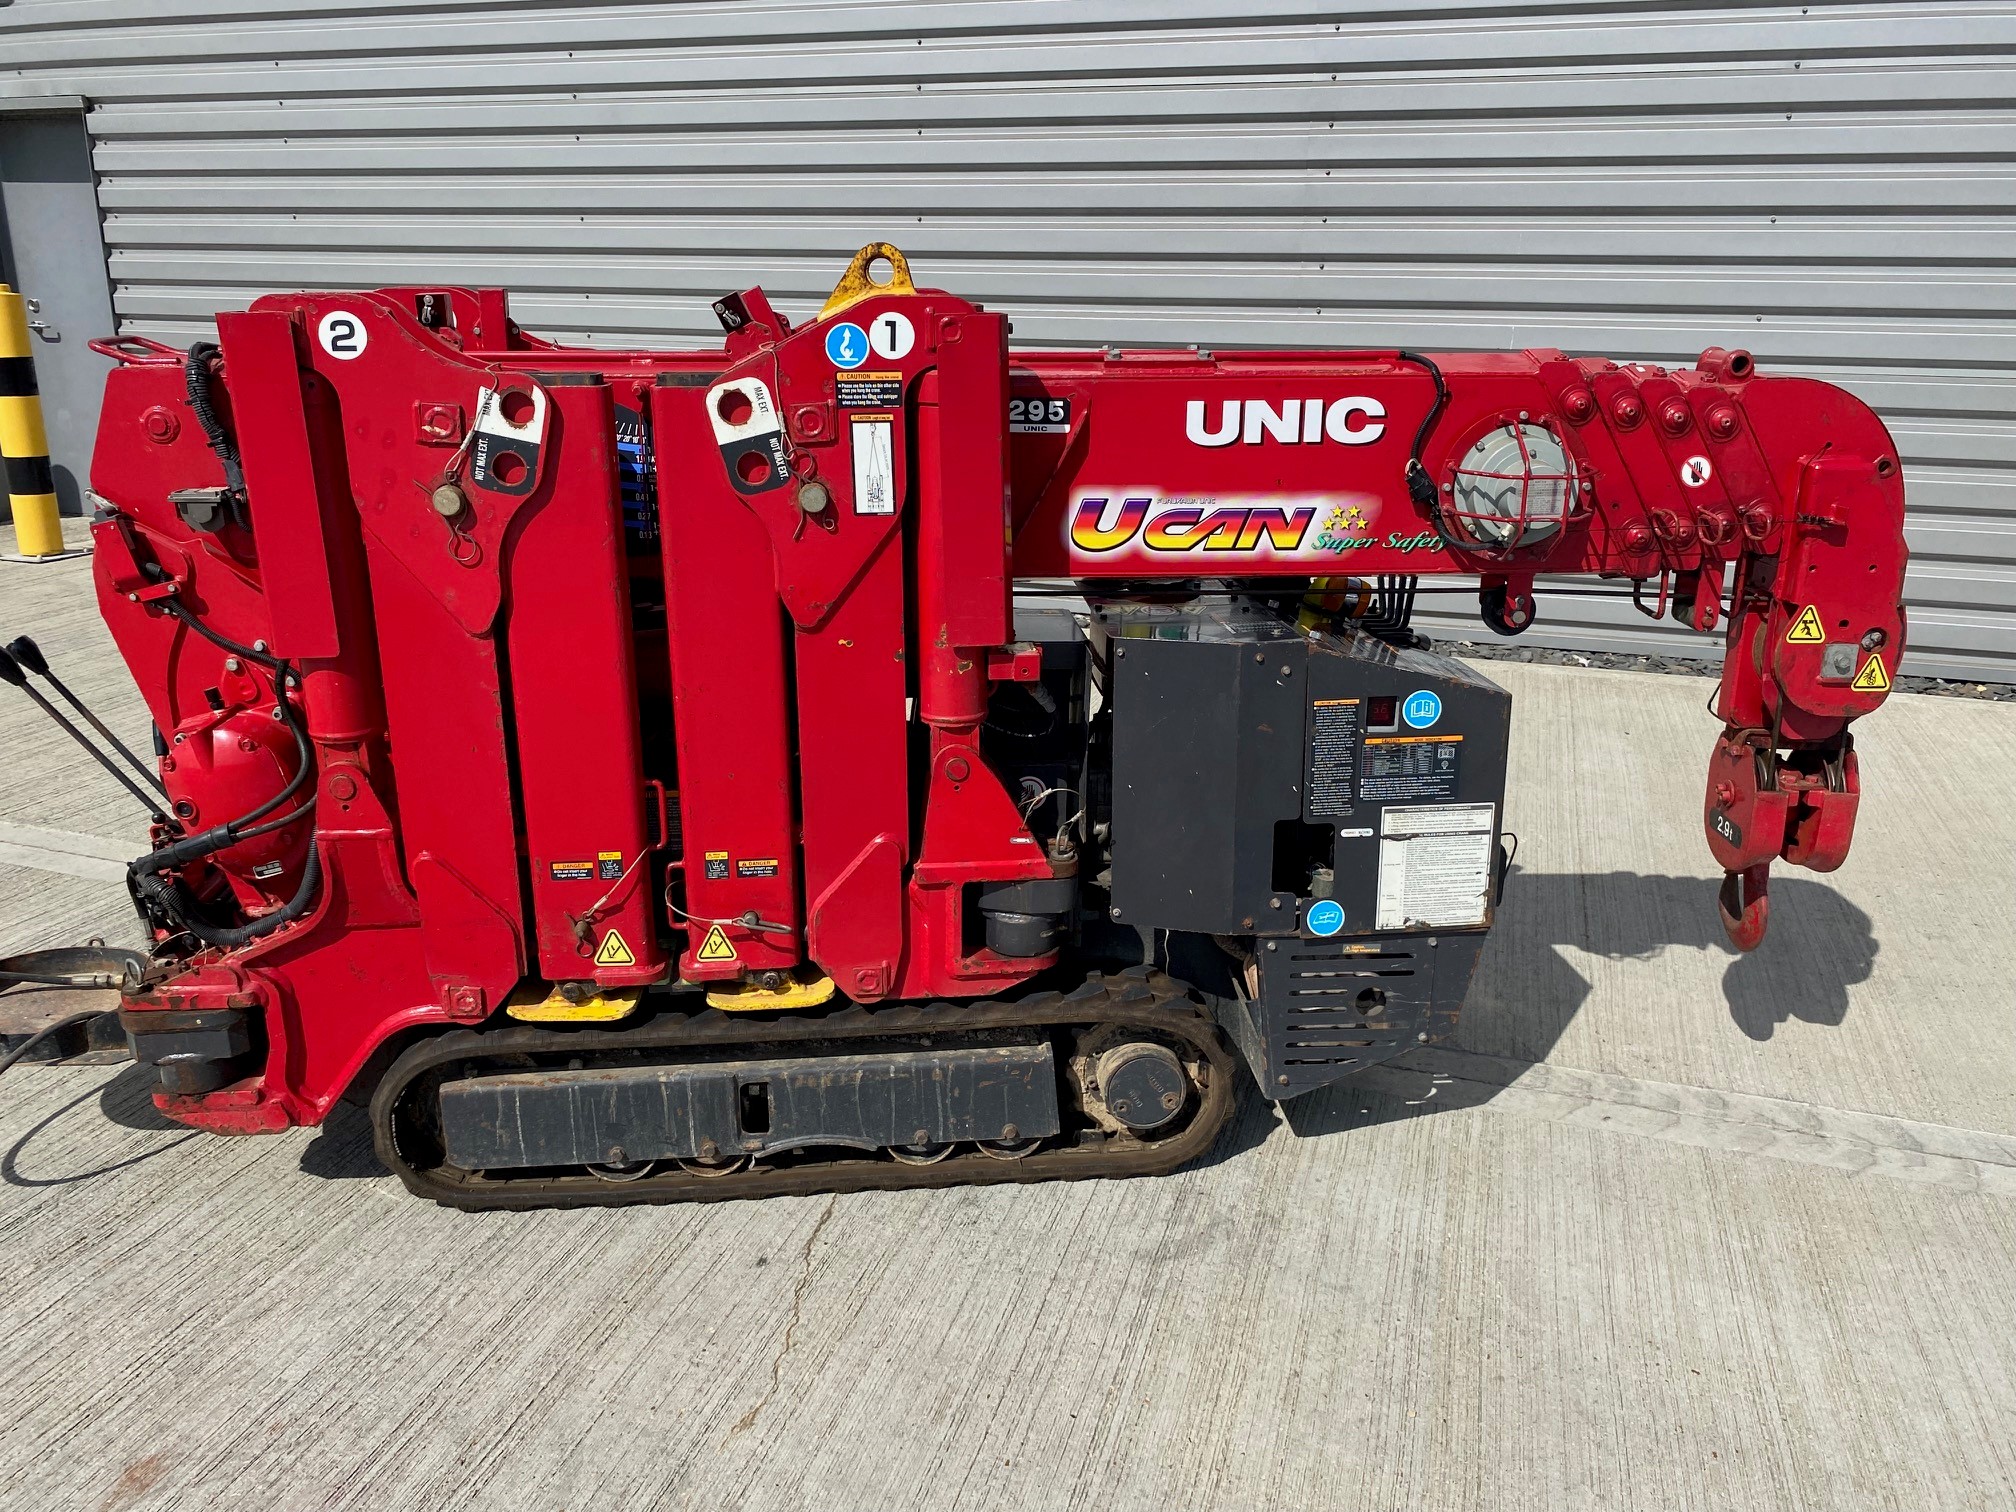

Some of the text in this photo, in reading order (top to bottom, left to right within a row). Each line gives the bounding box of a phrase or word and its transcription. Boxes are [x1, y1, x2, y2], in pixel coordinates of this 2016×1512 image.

[330, 320, 357, 351] 2
[885, 321, 896, 351] 1
[754, 386, 769, 416] MAX EXT.
[1009, 400, 1064, 421] 295
[1186, 396, 1388, 447] UNIC
[475, 438, 488, 480] NOT MAX EXT.
[769, 438, 789, 480] NOT MAX EXT.
[1311, 531, 1447, 555] Super Safety
[1717, 816, 1733, 840] 2.9t
